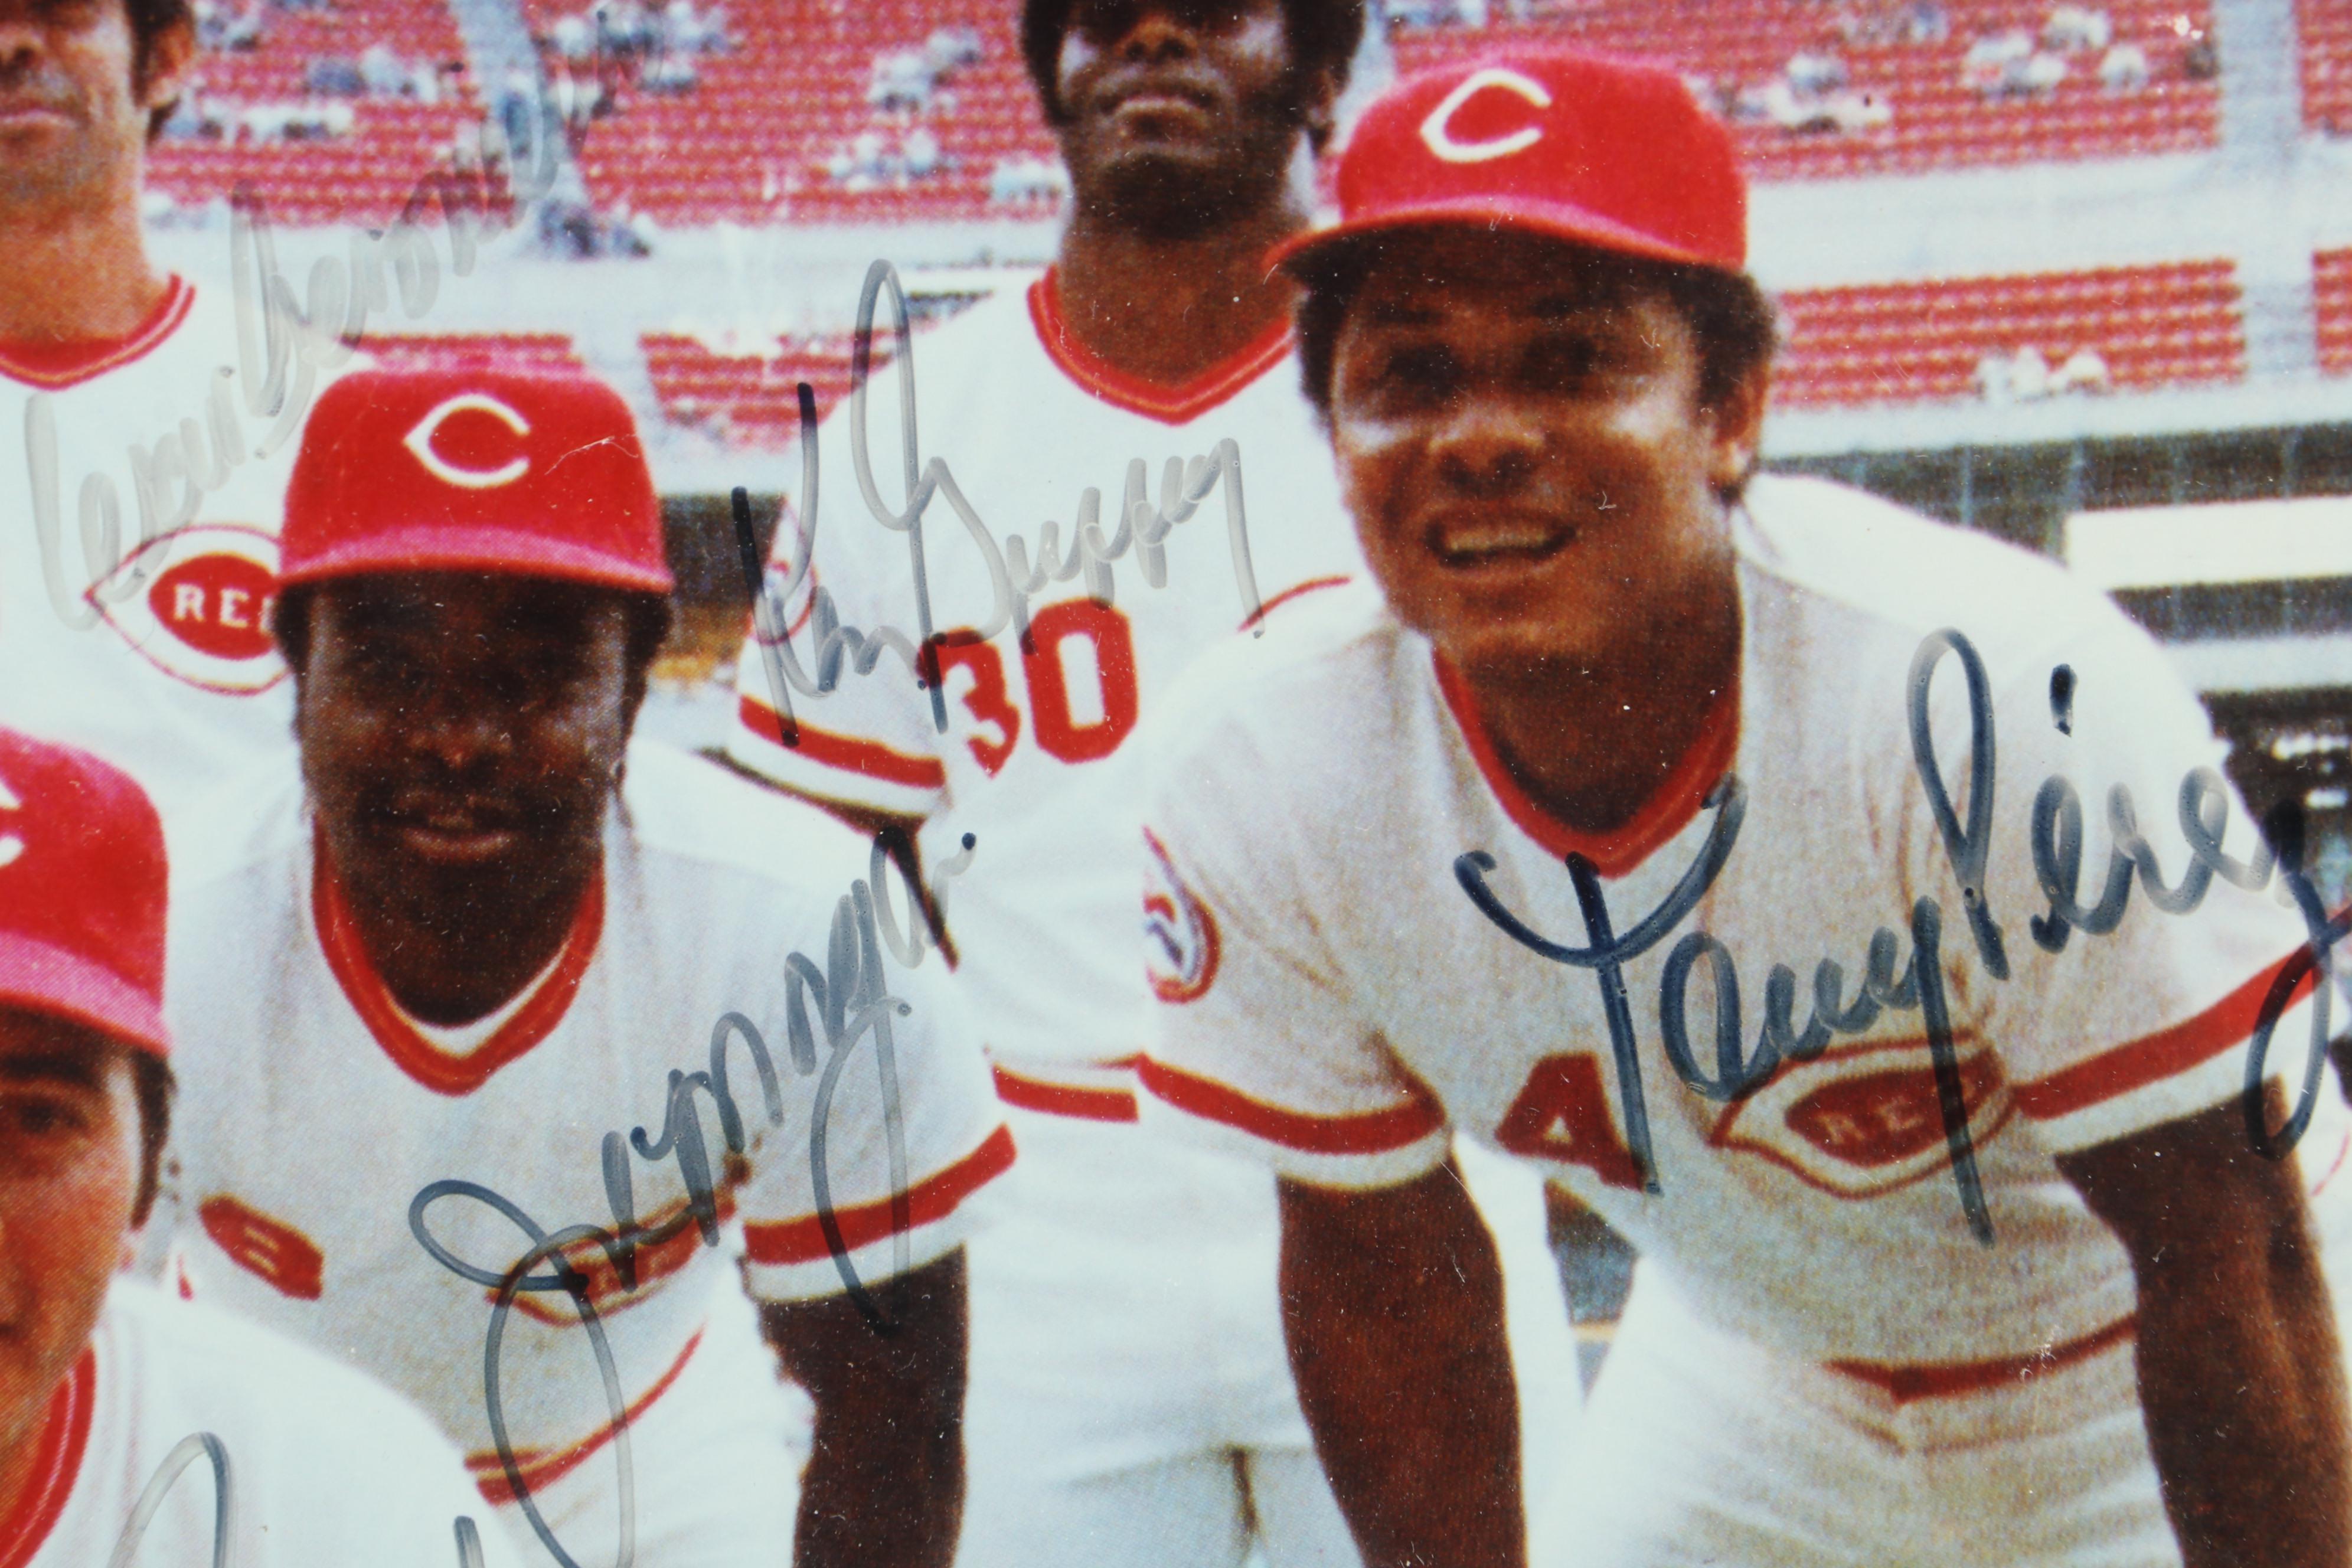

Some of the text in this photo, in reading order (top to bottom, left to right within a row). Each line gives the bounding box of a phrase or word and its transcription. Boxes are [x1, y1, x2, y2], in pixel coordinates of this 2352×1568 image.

[1420, 68, 1552, 162] C
[403, 391, 530, 488] C
[916, 594, 1141, 780] 30
